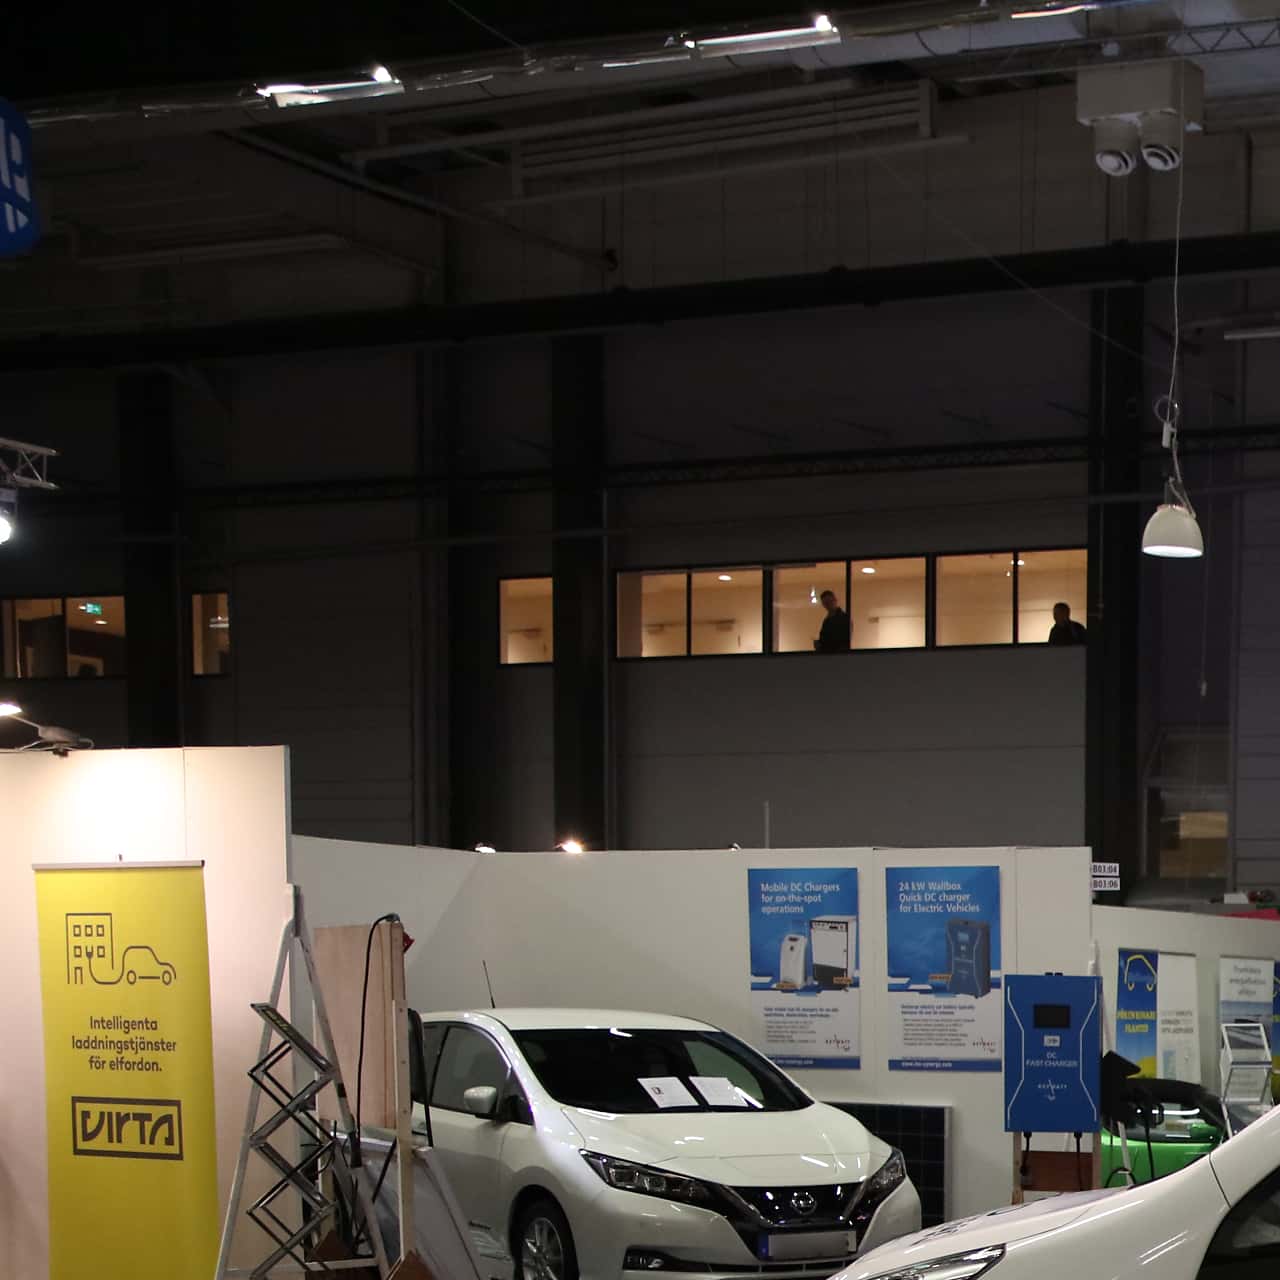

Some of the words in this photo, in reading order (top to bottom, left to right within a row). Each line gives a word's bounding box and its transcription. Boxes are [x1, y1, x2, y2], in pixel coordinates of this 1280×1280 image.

[760, 882, 788, 892] Mobile
[790, 882, 802, 892] DC
[803, 882, 840, 893] Chargers
[898, 882, 910, 892] 24
[928, 880, 962, 891] Wallbox
[761, 893, 773, 903] for
[775, 893, 822, 904] on-the-spot
[899, 892, 922, 903] Quick
[924, 892, 937, 902] DC
[938, 893, 971, 904] charger
[760, 903, 804, 915] operations
[899, 903, 912, 913] for
[913, 903, 944, 913] Electric
[946, 903, 980, 913] Vehicles
[89, 1016, 159, 1034] Intelligenta
[71, 1035, 177, 1054] laddningstjänster
[88, 1055, 106, 1071] för
[109, 1057, 163, 1072] elfordon.
[80, 1110, 175, 1147] VIRTA
